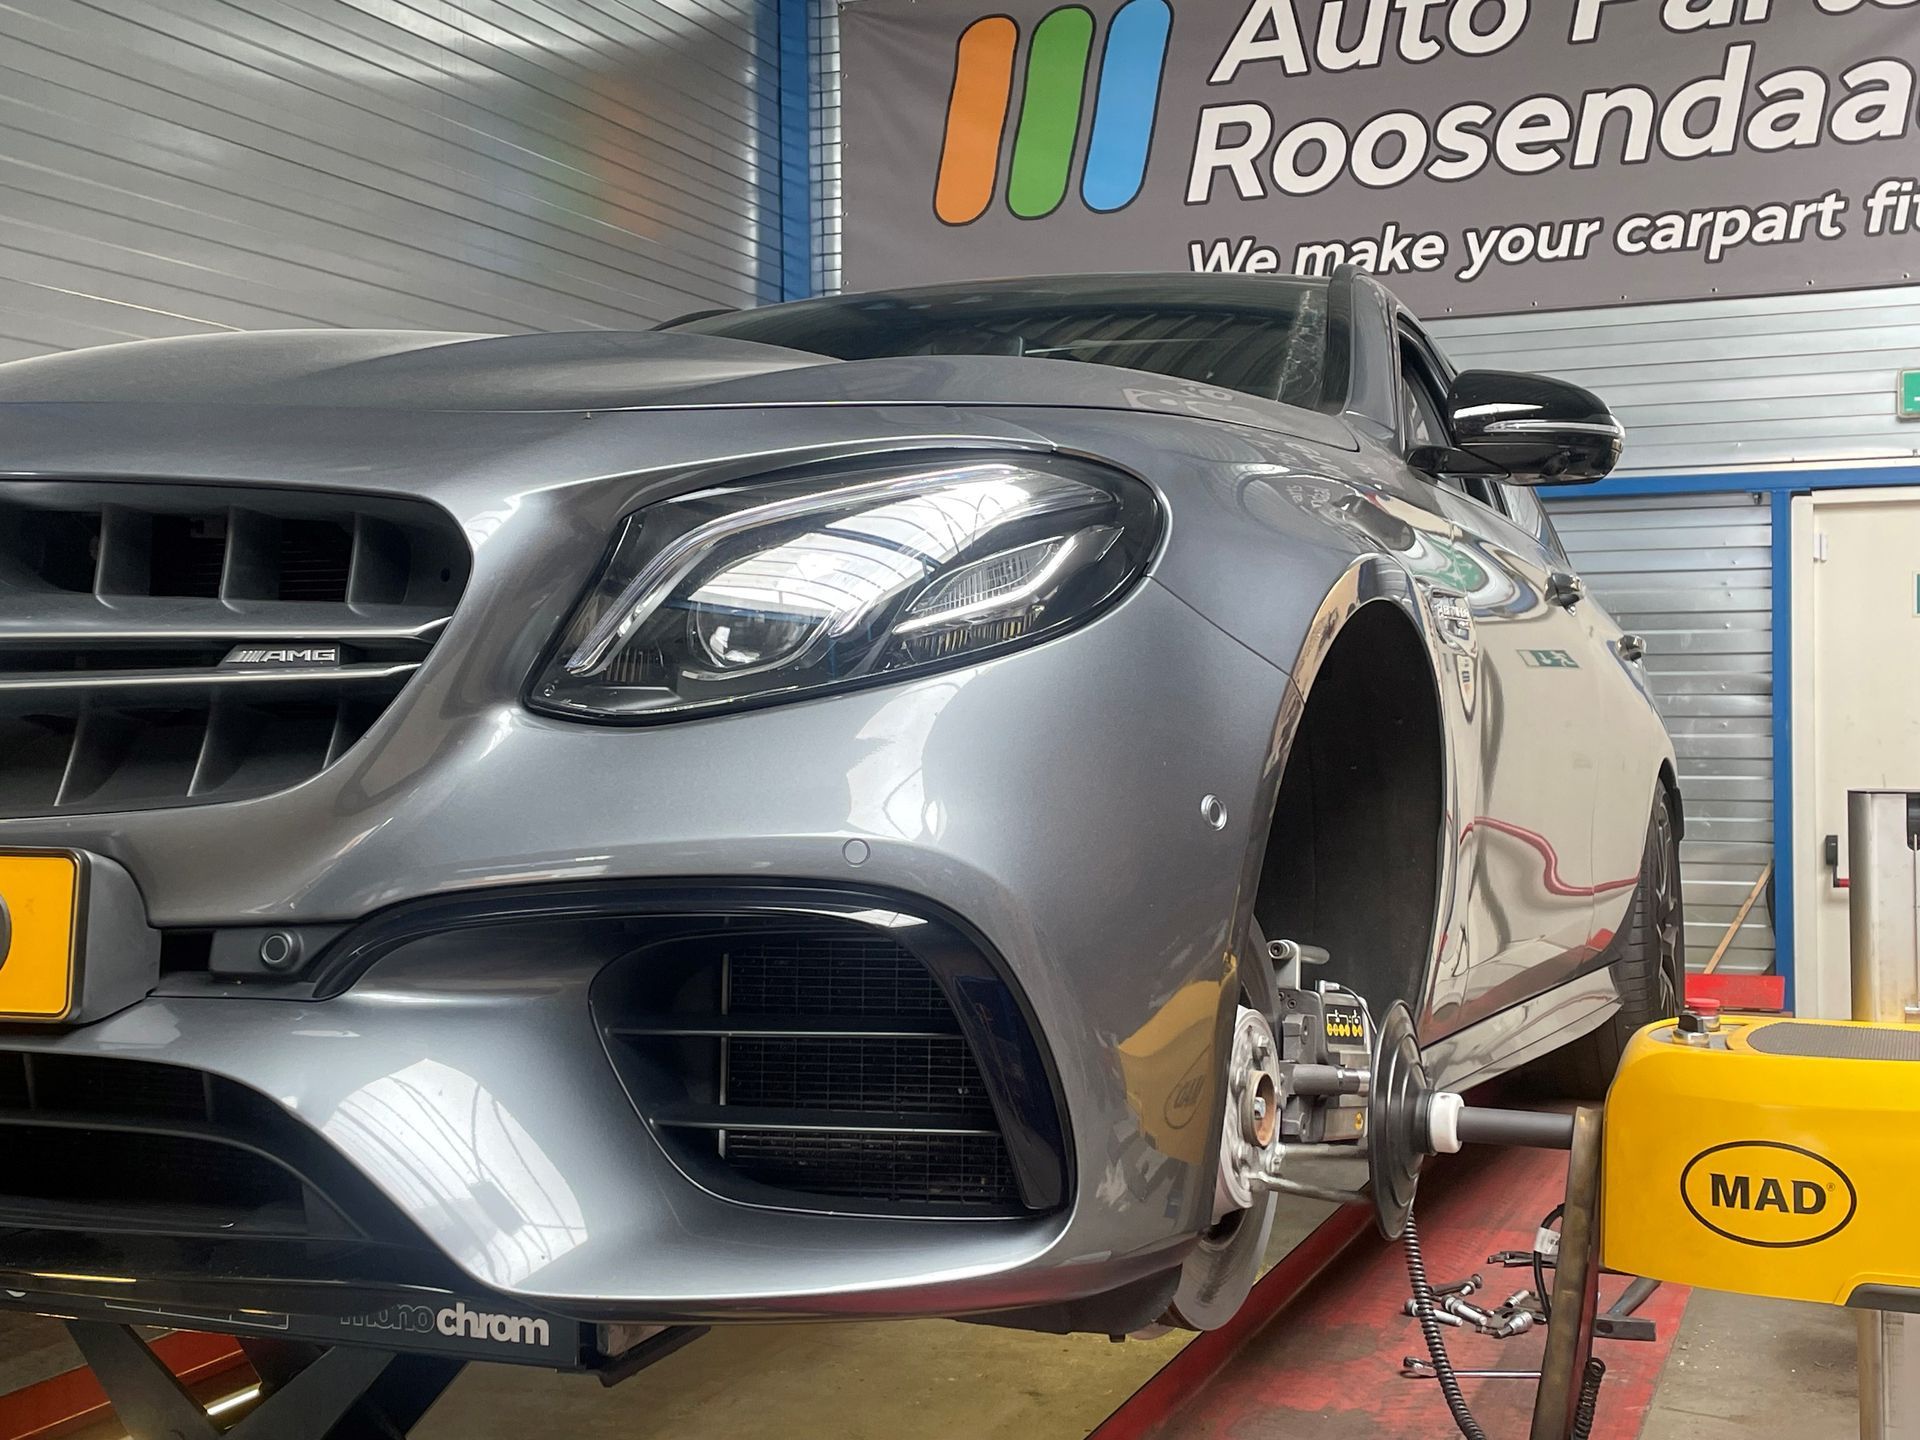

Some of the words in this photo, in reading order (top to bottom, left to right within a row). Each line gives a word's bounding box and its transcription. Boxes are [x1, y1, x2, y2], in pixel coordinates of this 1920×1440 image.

[1207, 0, 1529, 84] Auto
[1186, 42, 1917, 201] Roosendaa
[1190, 238, 1280, 273] We
[1295, 224, 1446, 277] make
[1458, 218, 1601, 280] your
[1615, 192, 1847, 261] carpart
[258, 648, 336, 663] AMG
[1709, 1172, 1827, 1215] MAD
